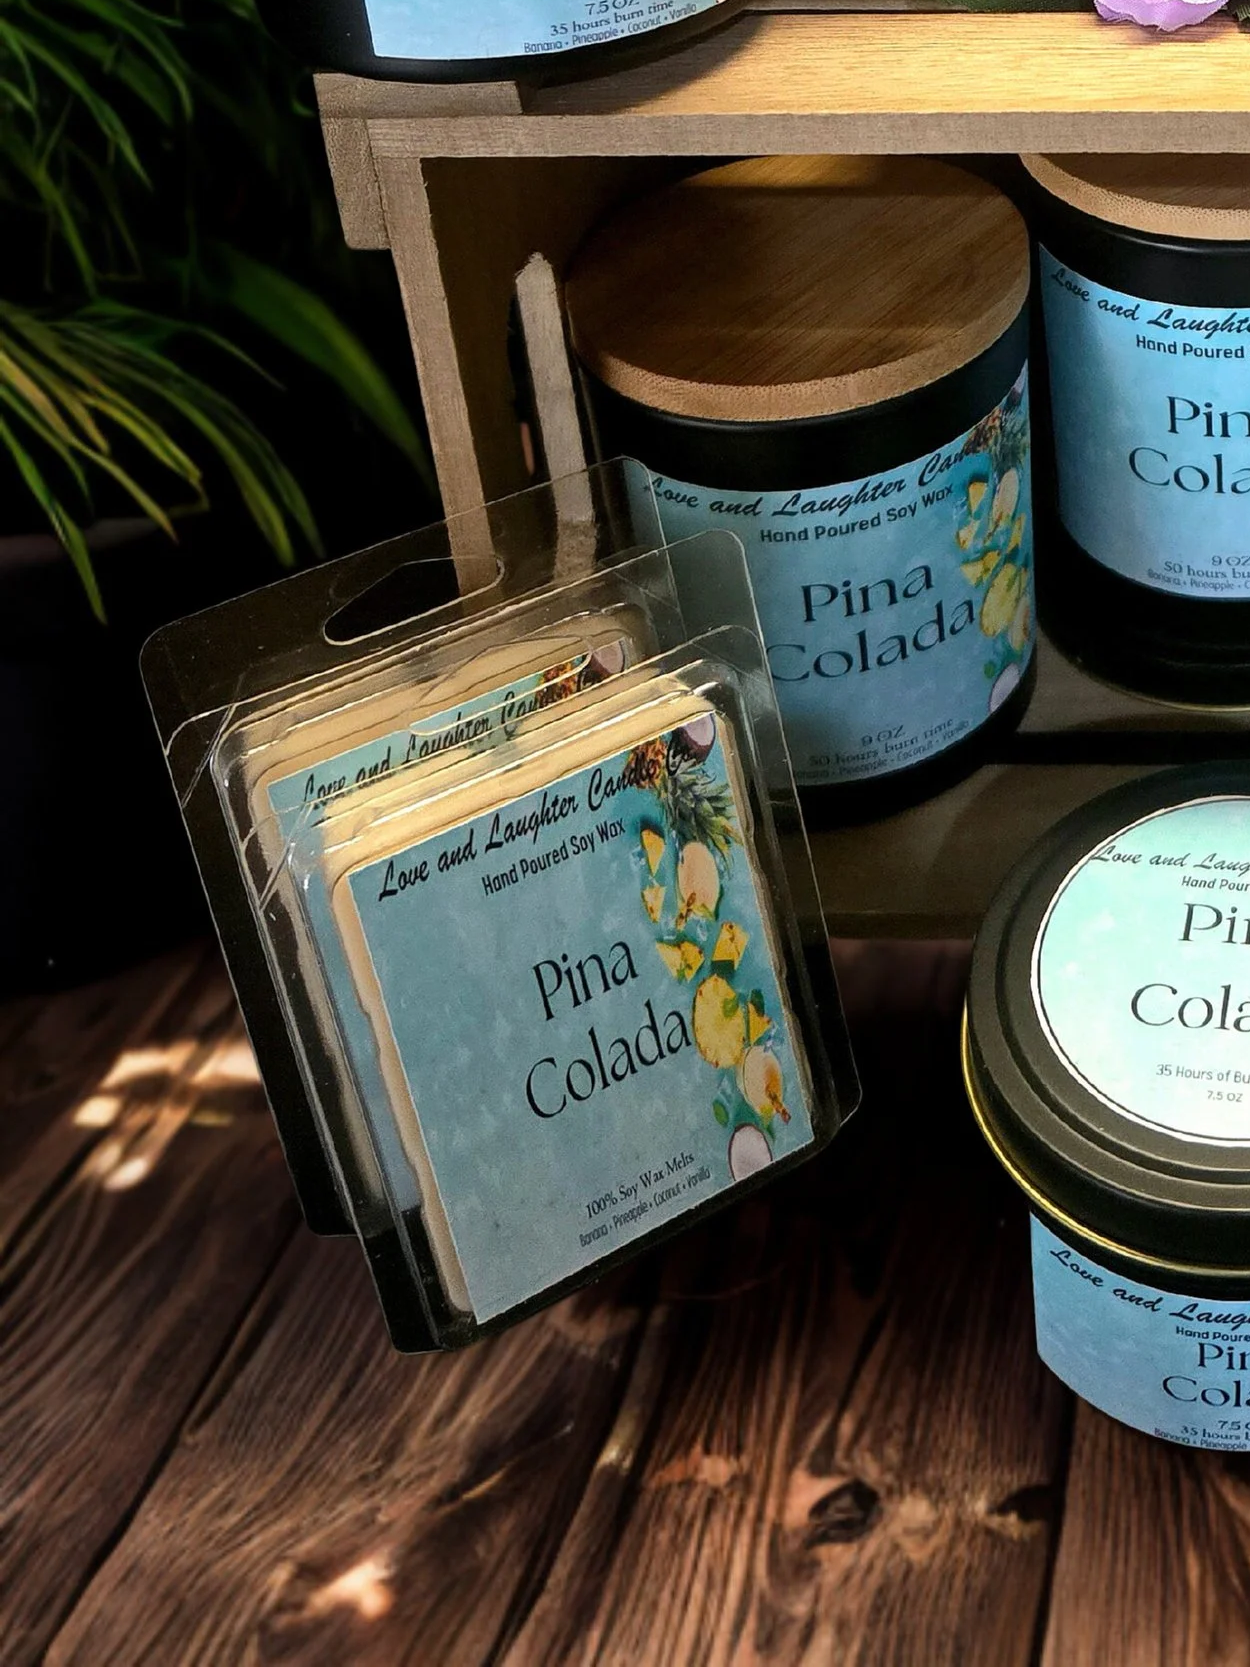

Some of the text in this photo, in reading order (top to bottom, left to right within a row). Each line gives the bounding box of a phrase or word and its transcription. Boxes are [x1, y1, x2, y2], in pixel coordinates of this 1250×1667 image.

[1051, 267, 1090, 302] Love
[1097, 299, 1139, 321] and
[1136, 335, 1177, 355] Hand
[1183, 344, 1244, 359] Poured
[760, 483, 954, 543] Hand Poured Soy Wax
[772, 478, 906, 516] Laughter
[801, 563, 935, 623] Pina
[766, 599, 976, 682] Colada
[377, 792, 580, 902] Love and Laughter
[481, 817, 627, 896] Hand Poured Soy Wax
[1092, 845, 1141, 865] Love
[1149, 852, 1187, 867] and
[1181, 876, 1216, 890] Hand
[533, 940, 638, 1020] Pina
[526, 999, 692, 1119] Colada
[1156, 1063, 1172, 1077] 35
[1175, 1066, 1213, 1081] Hours
[1217, 1070, 1231, 1082] of
[1207, 1090, 1243, 1102] 7.5 OZ
[586, 1150, 695, 1219] 100% Soy Wax Melts
[1050, 1249, 1104, 1288] Love
[1113, 1287, 1161, 1313] and
[1176, 1326, 1209, 1339] Hand
